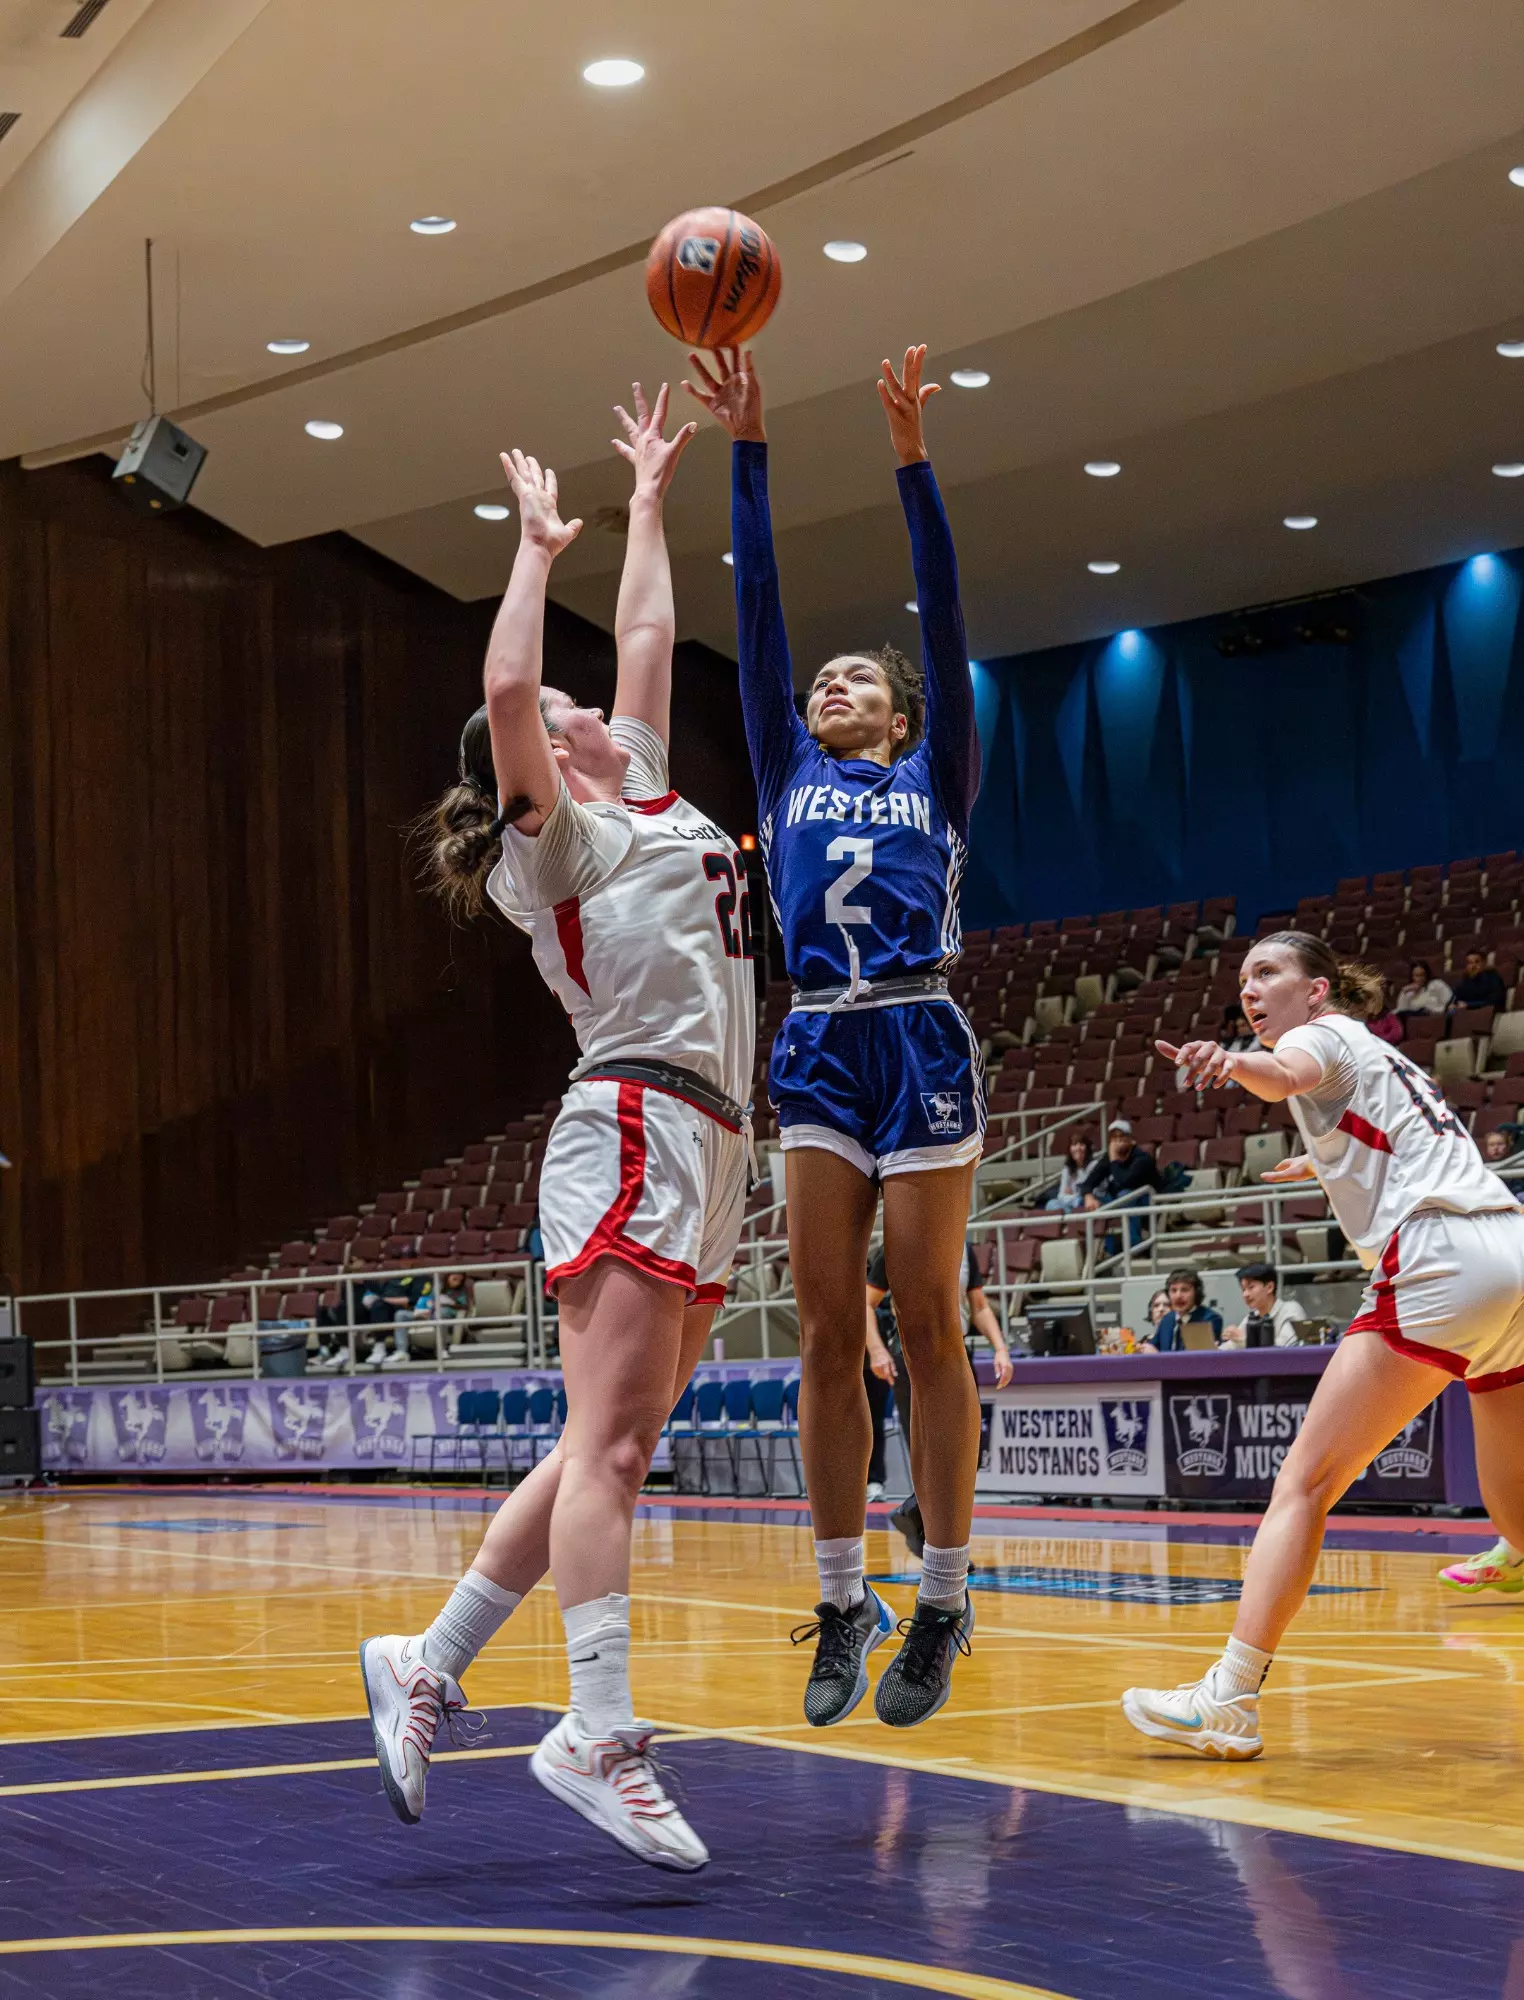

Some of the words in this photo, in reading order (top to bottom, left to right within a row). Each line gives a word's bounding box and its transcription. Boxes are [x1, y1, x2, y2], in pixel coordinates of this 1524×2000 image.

[785, 784, 931, 836] WESTERN
[825, 836, 874, 924] 2
[1001, 1408, 1094, 1439] WESTERN
[999, 1446, 1100, 1477] MUSTANGS
[1234, 1444, 1291, 1480] MUS
